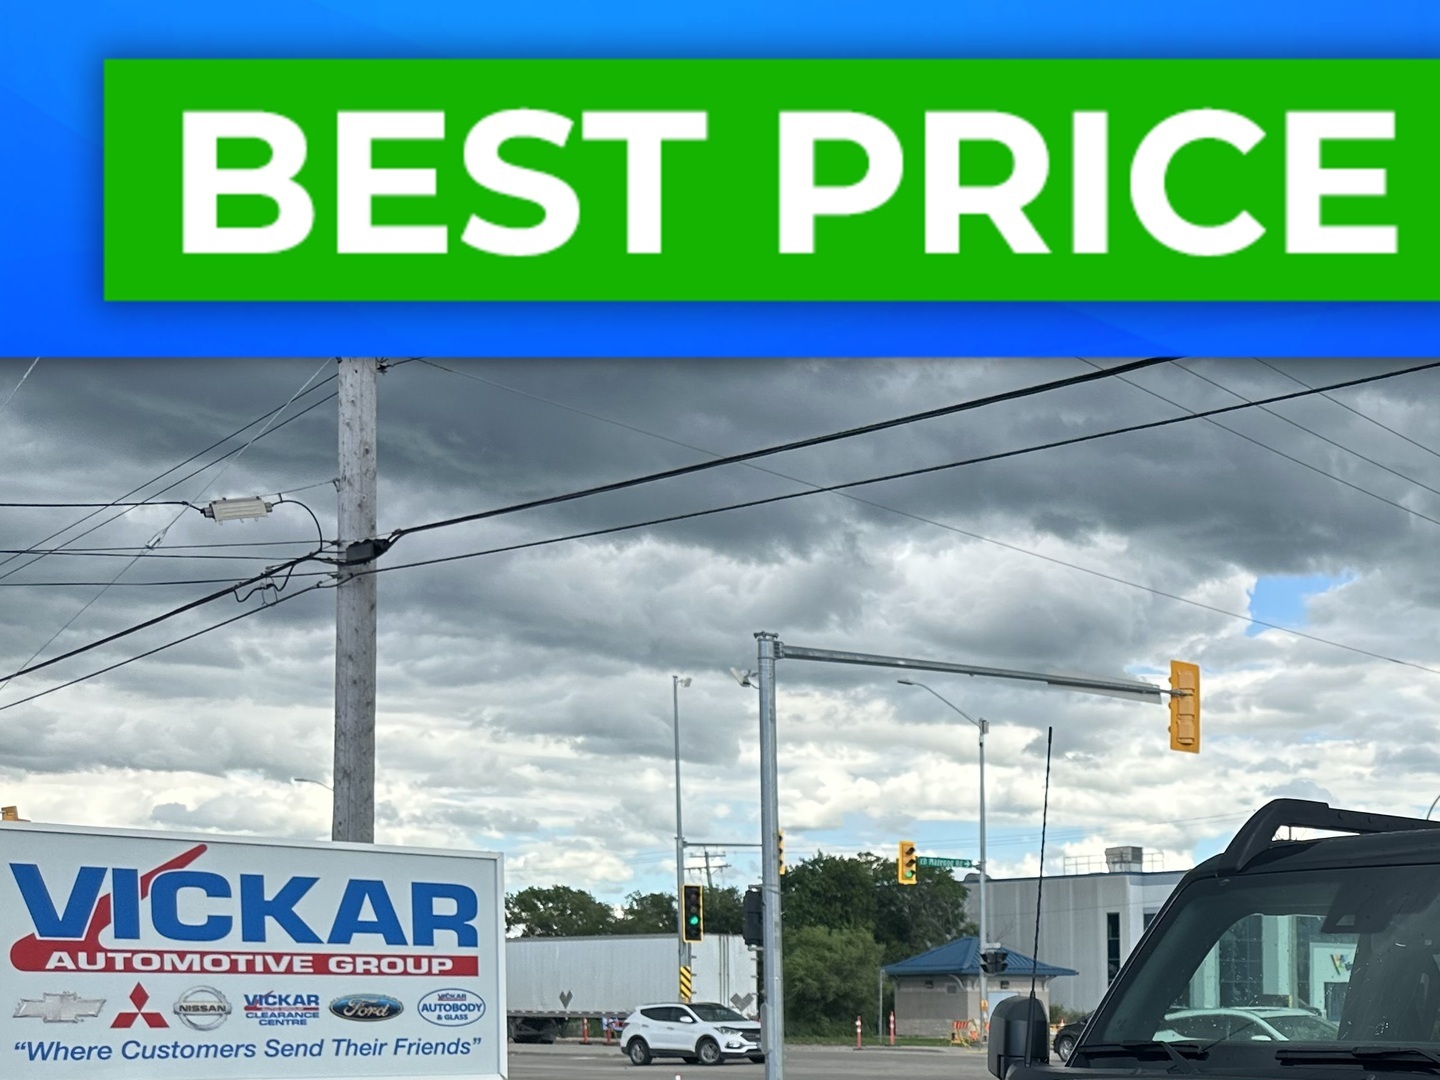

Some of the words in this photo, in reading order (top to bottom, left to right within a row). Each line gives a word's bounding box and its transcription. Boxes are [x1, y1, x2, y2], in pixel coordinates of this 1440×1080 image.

[9, 863, 479, 948] VICKAR
[45, 950, 314, 973] AUTOMOTIVE
[328, 955, 455, 975] GROUP
[179, 1004, 227, 1013] NISSAN
[244, 994, 320, 1006] VICKAR
[343, 999, 390, 1017] Ford
[421, 1003, 483, 1013] AUTOBODY
[121, 1040, 257, 1060] Customers
[264, 1038, 324, 1058] Send
[332, 1038, 388, 1057] Their
